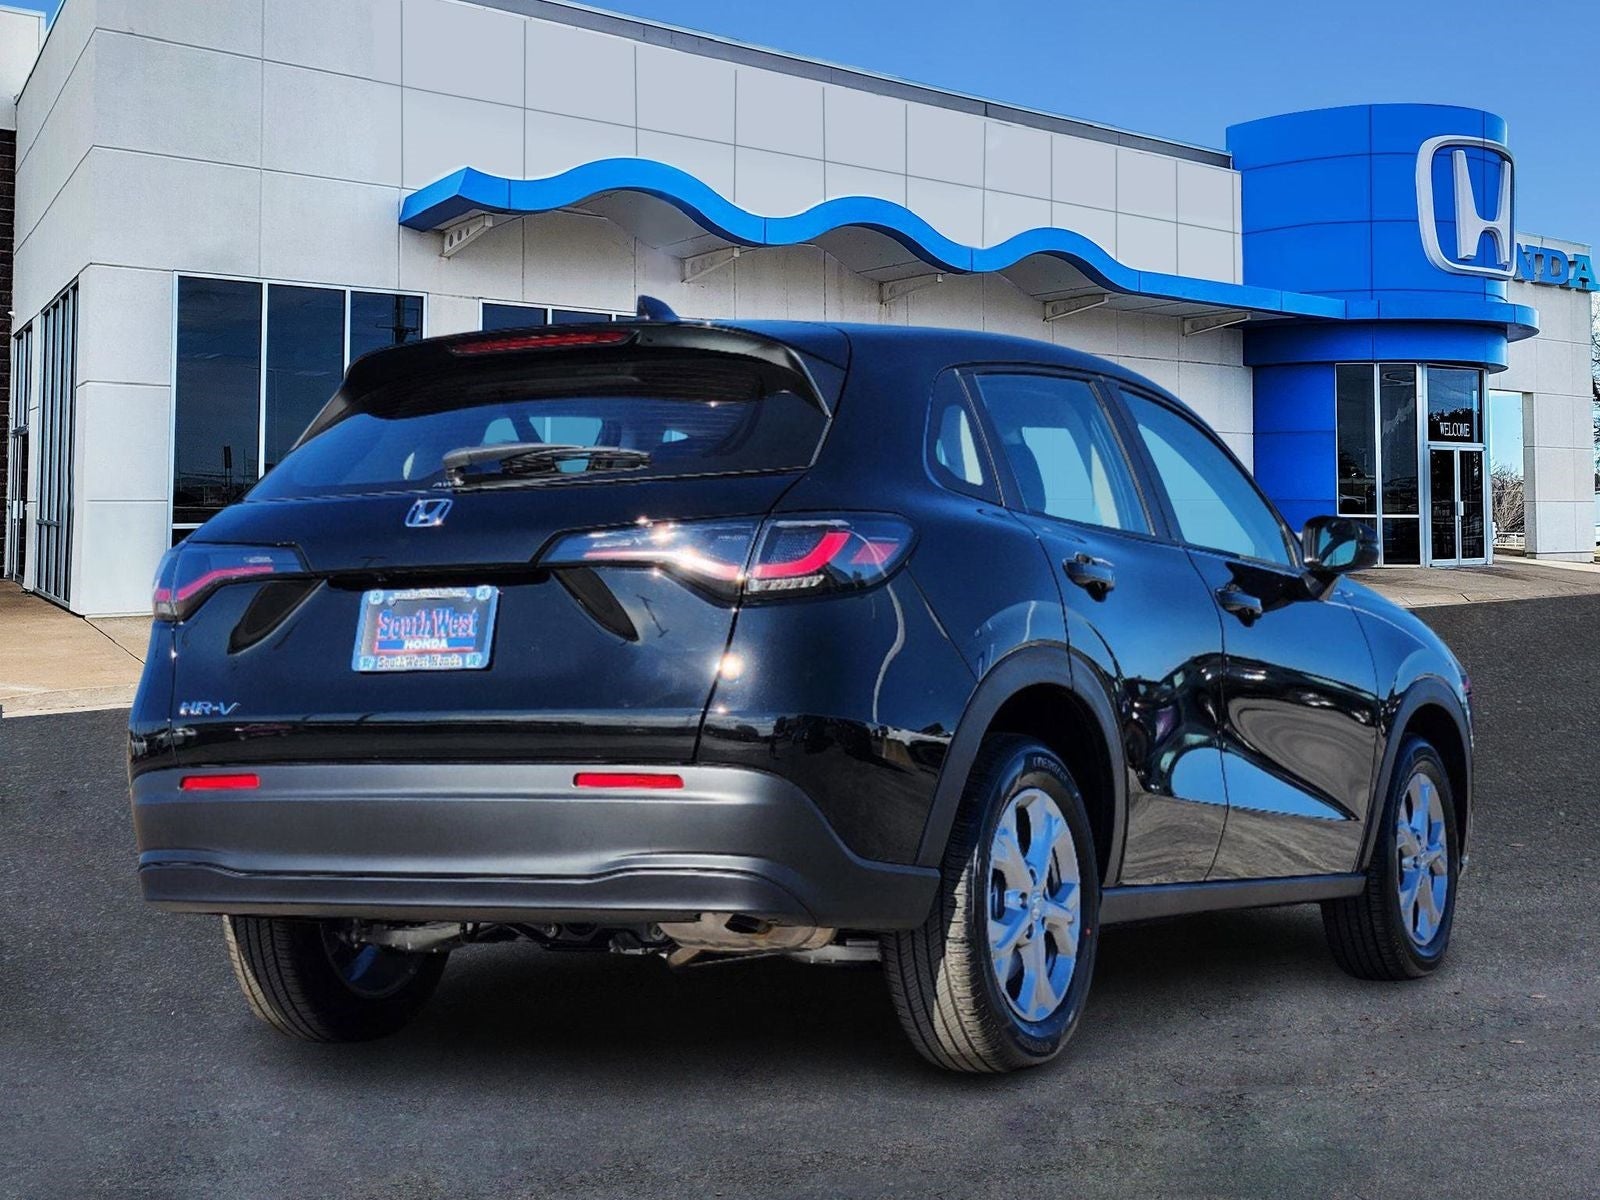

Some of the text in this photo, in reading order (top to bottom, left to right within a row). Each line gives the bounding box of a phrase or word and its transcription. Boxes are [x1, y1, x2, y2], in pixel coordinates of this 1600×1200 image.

[1439, 421, 1471, 438] WELCOME
[403, 638, 449, 650] HONDA
[179, 701, 241, 715] HR-V
